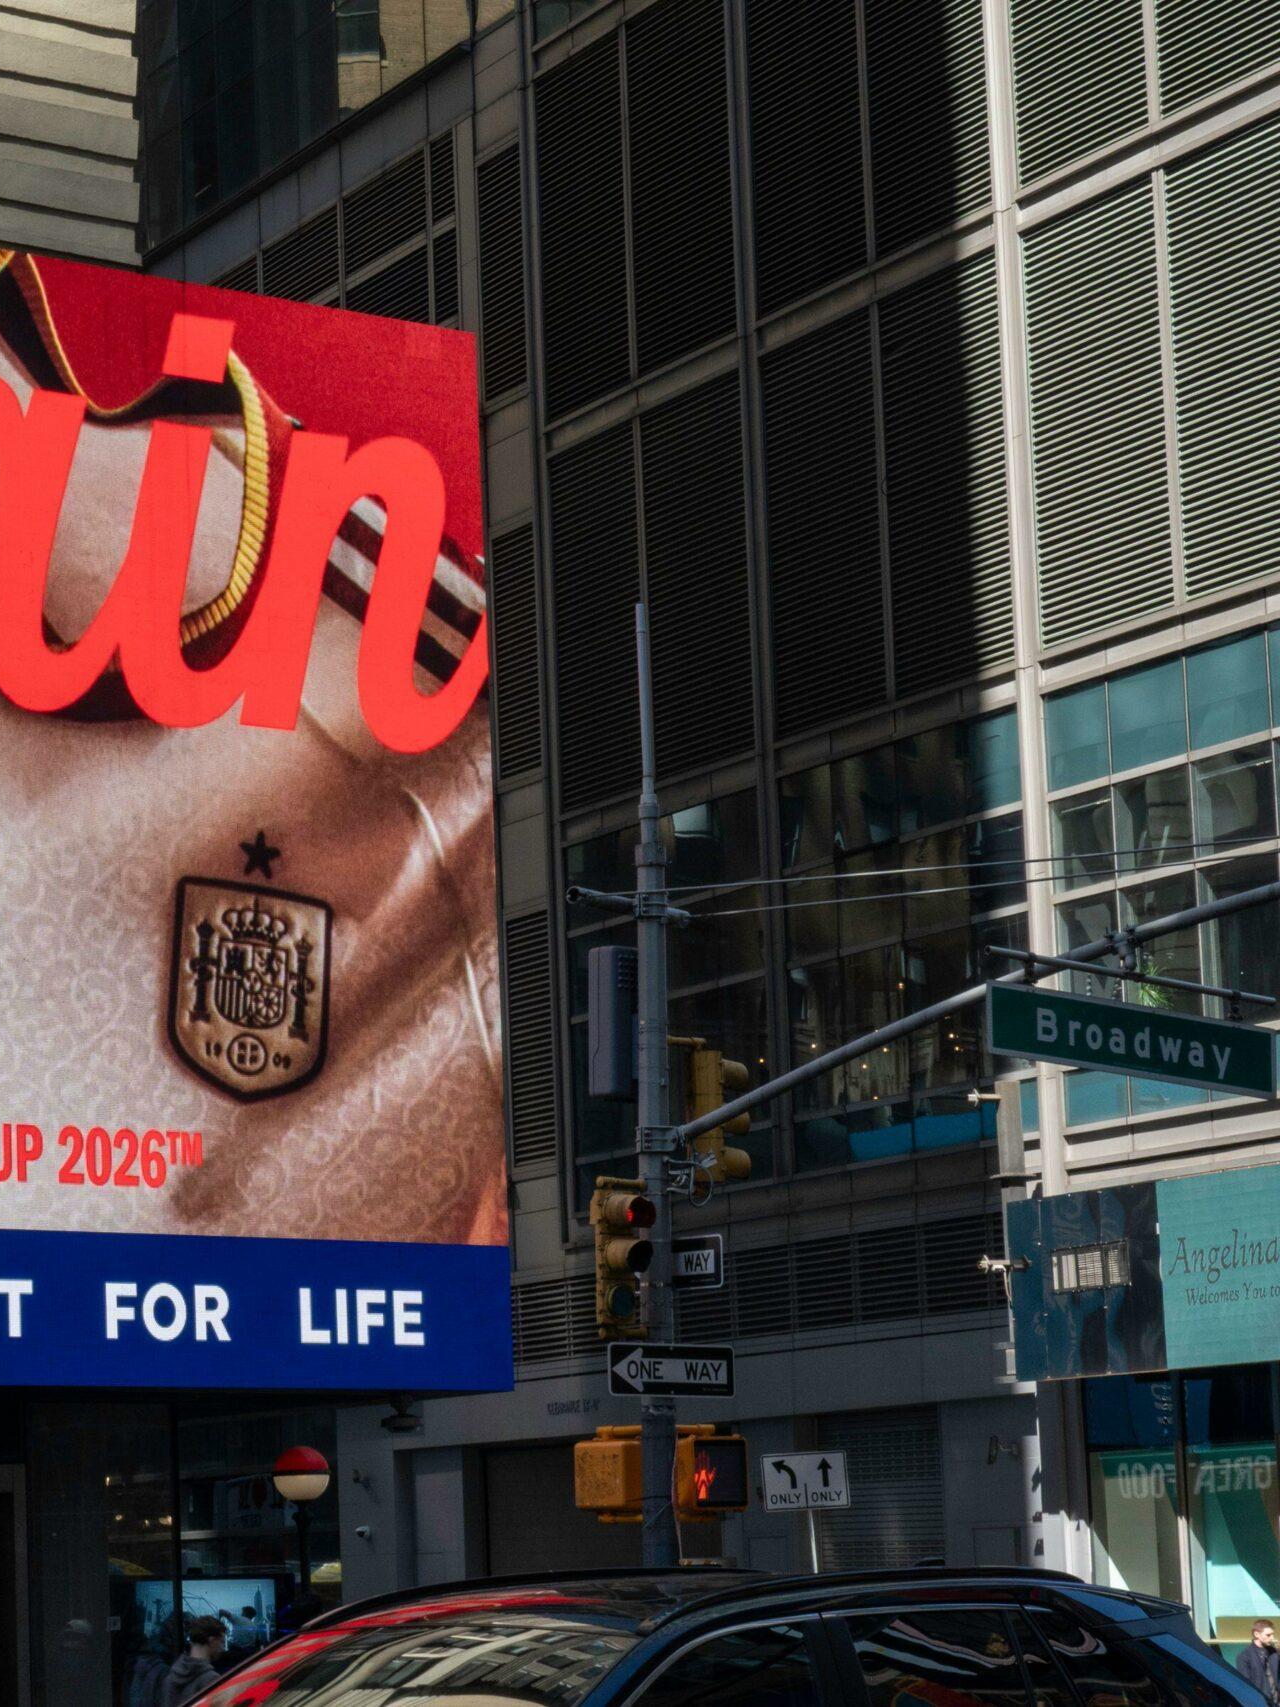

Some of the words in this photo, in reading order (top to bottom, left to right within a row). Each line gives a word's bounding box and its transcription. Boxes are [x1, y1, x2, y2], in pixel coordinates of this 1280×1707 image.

[1036, 1007, 1231, 1080] Broadway
[684, 1252, 711, 1273] WAY
[1168, 1229, 1280, 1284] Angelina
[1185, 1286, 1240, 1306] Welcomes
[1243, 1281, 1266, 1300] You
[105, 1282, 231, 1342] FOR
[299, 1287, 425, 1346] LIFE
[627, 1360, 663, 1380] ONE
[684, 1361, 723, 1381] WAY
[770, 1492, 801, 1505] ONLY
[811, 1490, 842, 1503] ONLY
